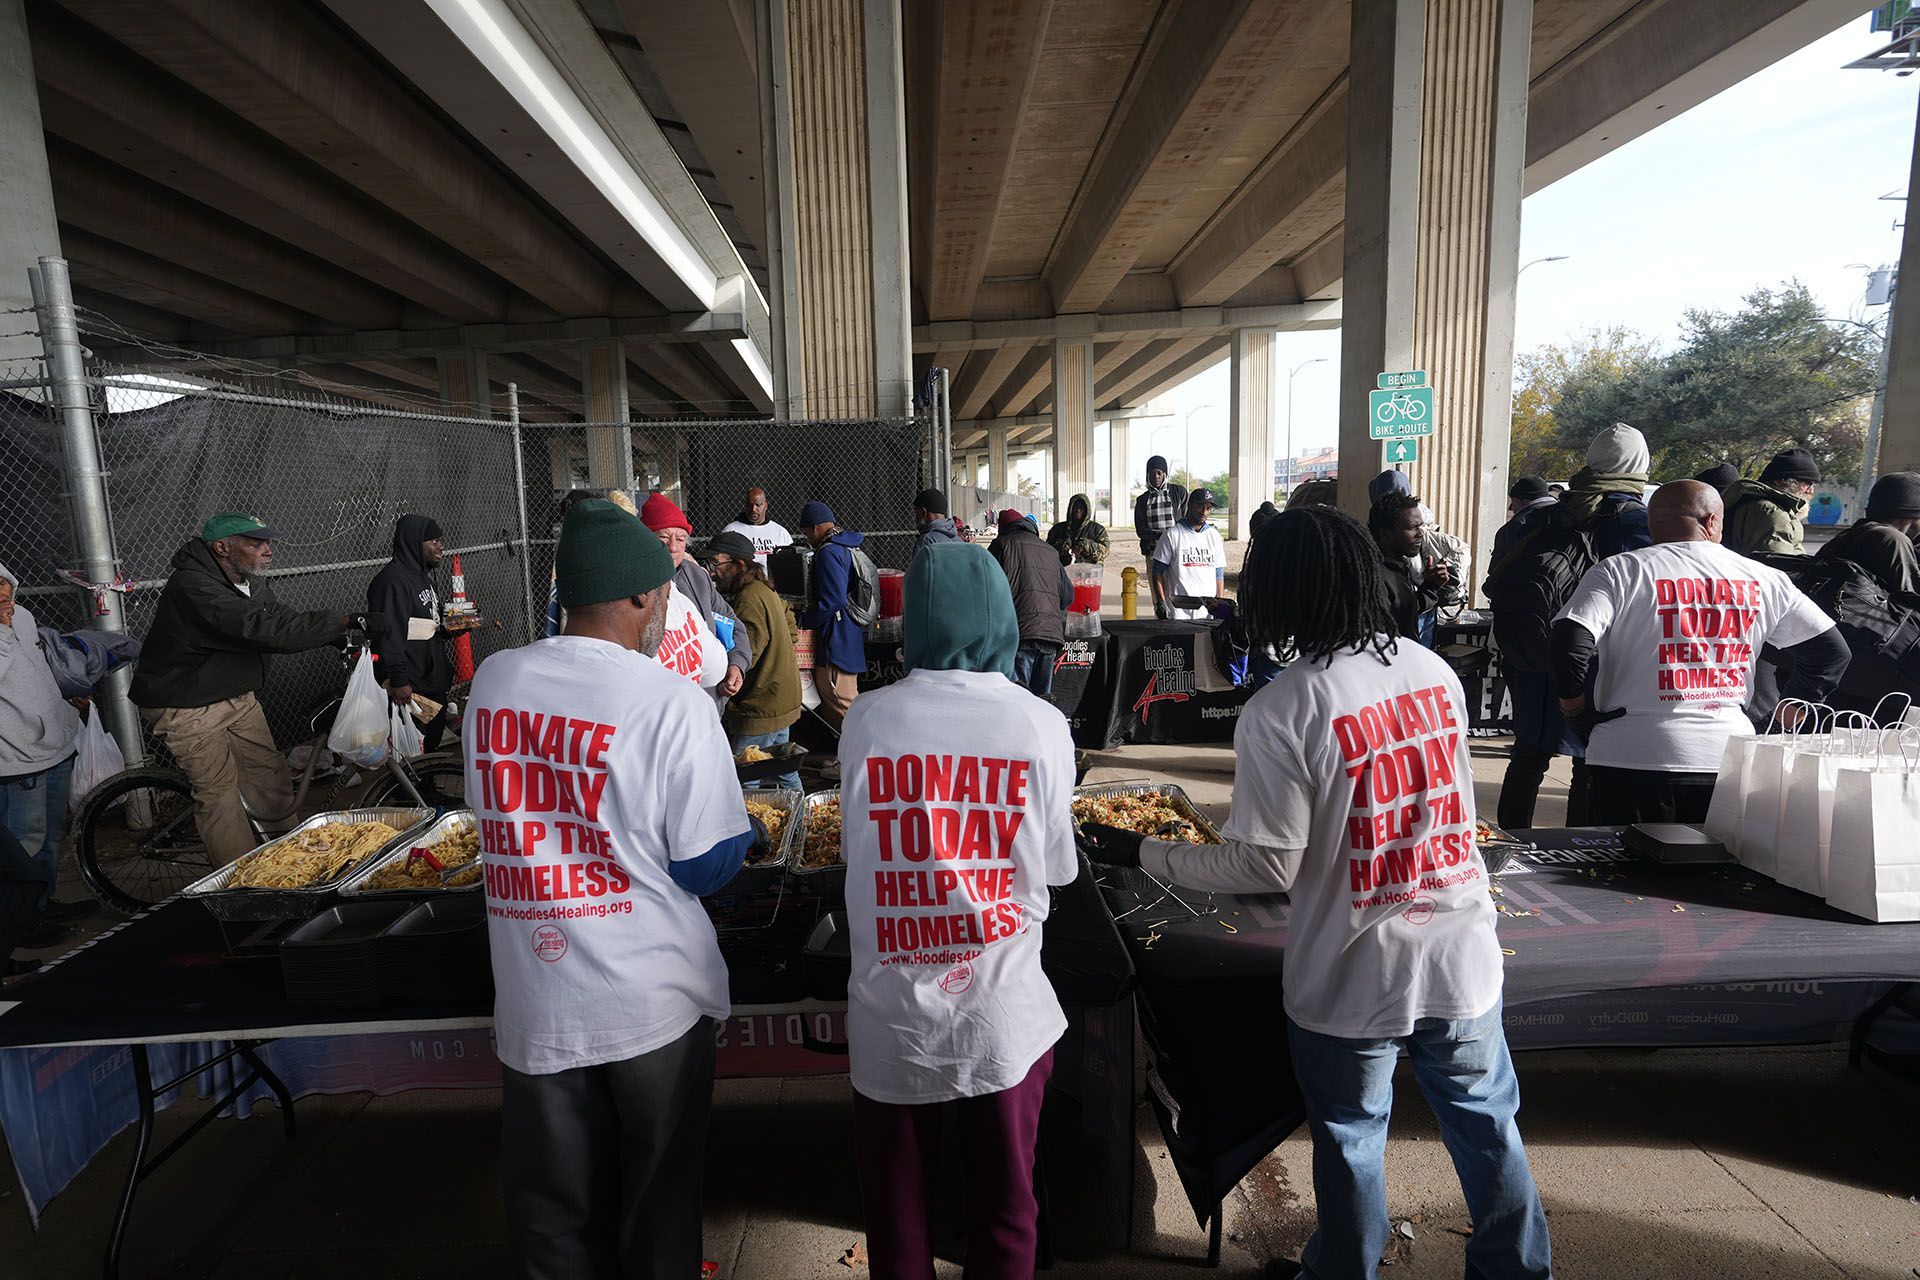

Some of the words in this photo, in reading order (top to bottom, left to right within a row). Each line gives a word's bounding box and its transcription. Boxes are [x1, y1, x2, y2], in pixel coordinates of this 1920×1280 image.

[1387, 374, 1416, 385] BEGIN
[1375, 425, 1395, 436] BIKE
[1398, 423, 1428, 434] ROUTE
[1655, 577, 1761, 607] DONATE
[1657, 607, 1759, 638] TODAY
[1062, 639, 1088, 651] oodies
[1067, 650, 1096, 663] Healing
[1143, 644, 1184, 670] Hoodies
[1714, 643, 1752, 664] THE
[1156, 667, 1196, 696] Healing
[476, 708, 617, 769] DONATE
[1332, 685, 1456, 762] DONATE
[475, 759, 608, 822] TODAY
[866, 754, 1030, 806] DONATE
[1346, 732, 1458, 809] TODAY
[481, 818, 547, 857] HELP
[555, 821, 615, 861] THE
[869, 807, 1025, 863] TODAY
[1349, 803, 1422, 850] HELP
[1426, 791, 1468, 830] TH
[485, 861, 631, 902] HOMELESS
[874, 870, 958, 907] HELP
[957, 867, 1016, 903] THE
